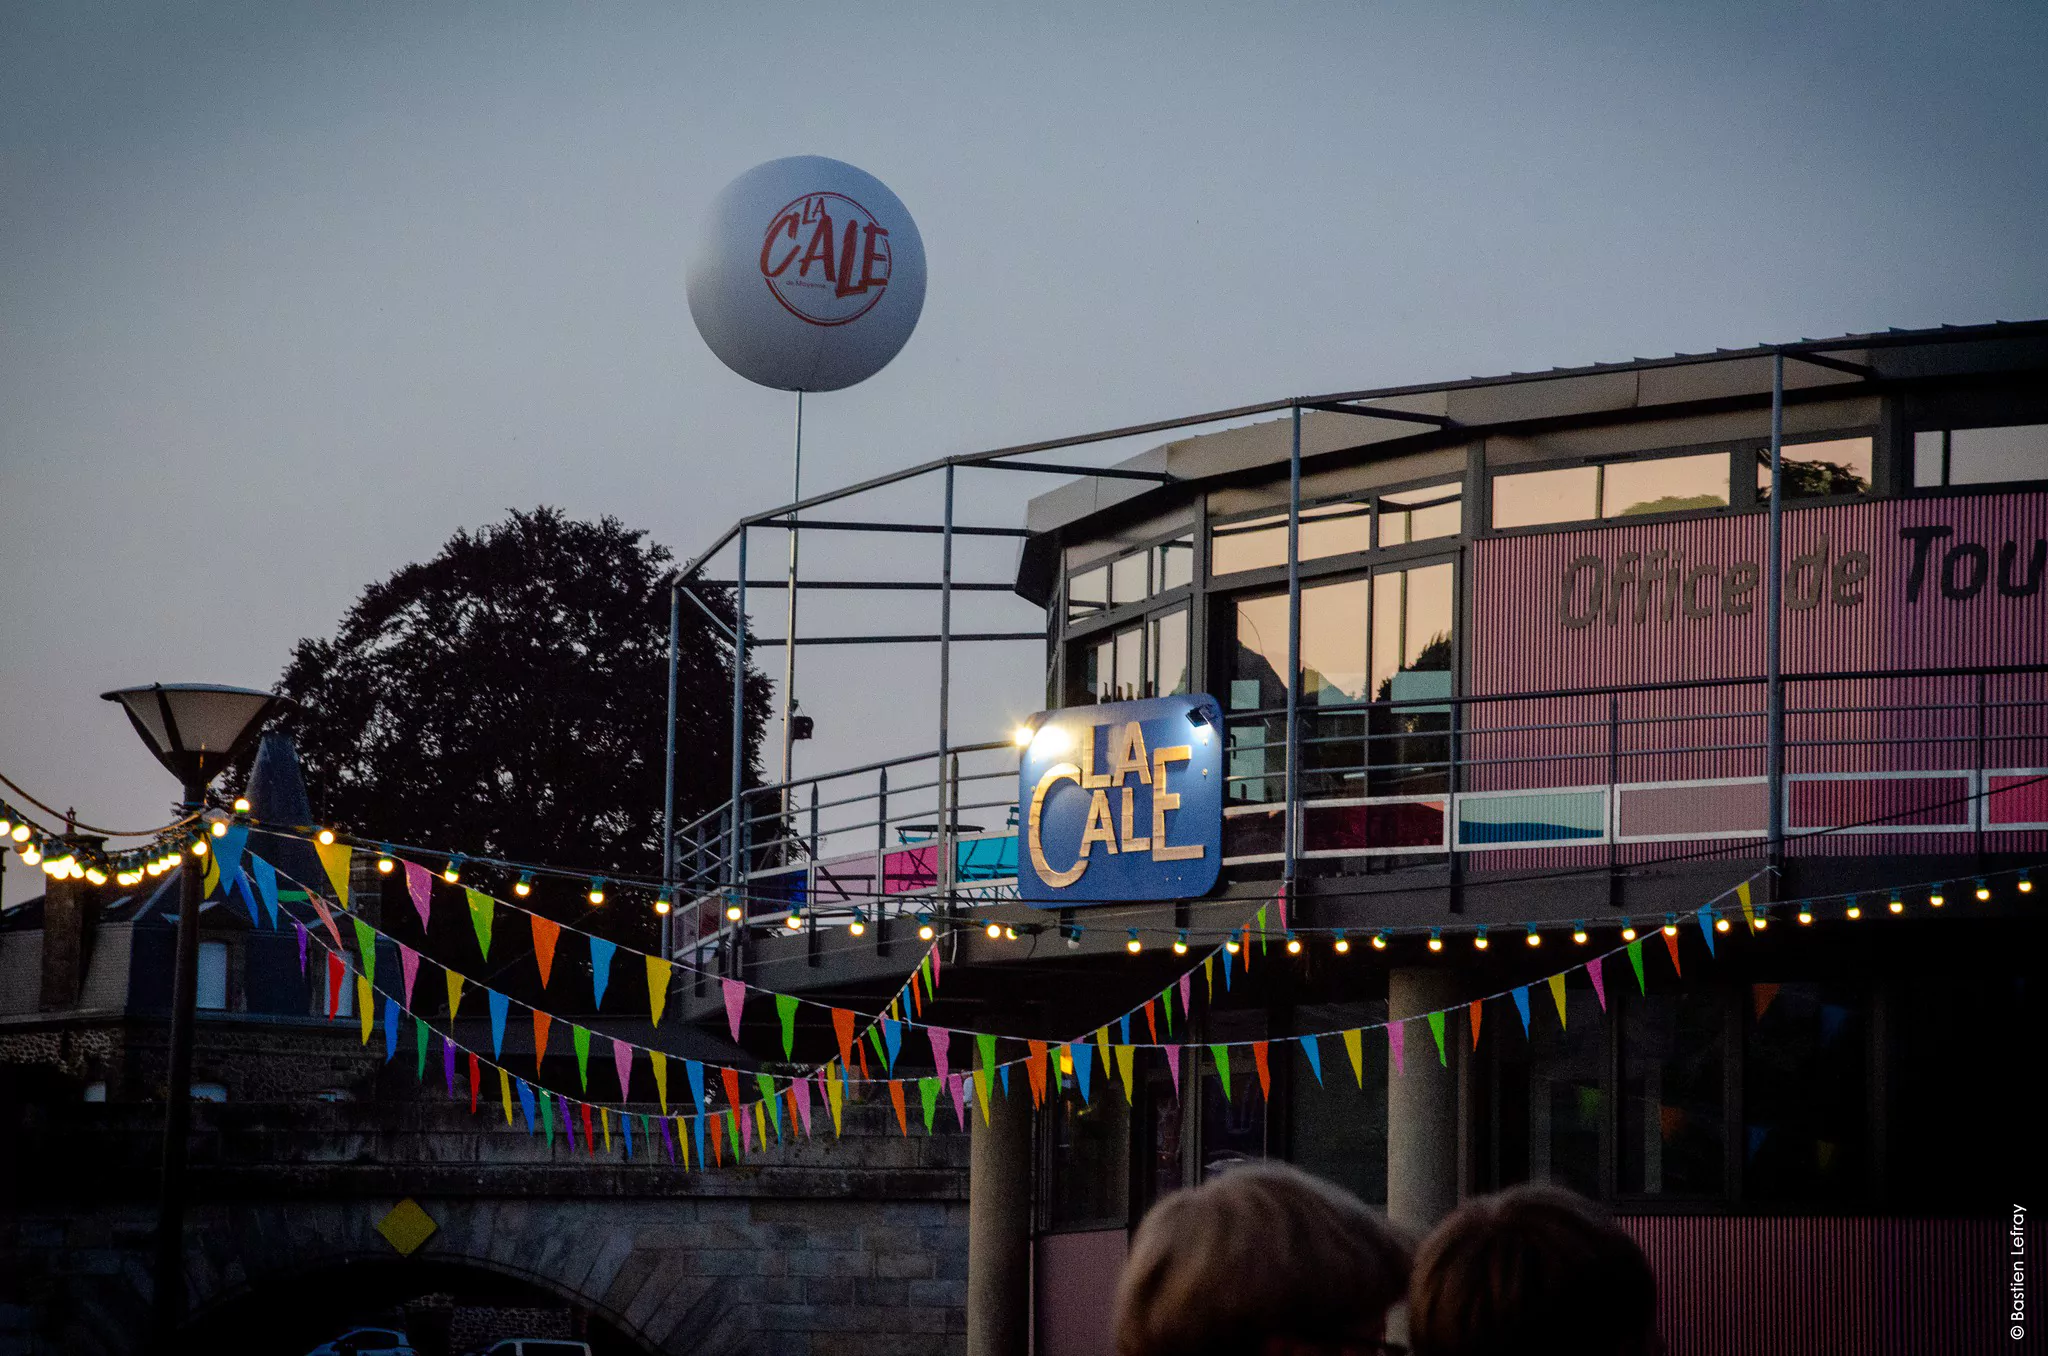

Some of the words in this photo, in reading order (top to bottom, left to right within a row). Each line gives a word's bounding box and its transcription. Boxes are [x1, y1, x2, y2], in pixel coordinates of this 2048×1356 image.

[802, 197, 826, 225] LA
[760, 212, 889, 298] CALE
[1560, 548, 1759, 629] Office
[1785, 532, 1869, 611] de
[1899, 526, 2048, 602] Tou
[1082, 721, 1152, 789] LA
[1028, 744, 1204, 888] CALE
